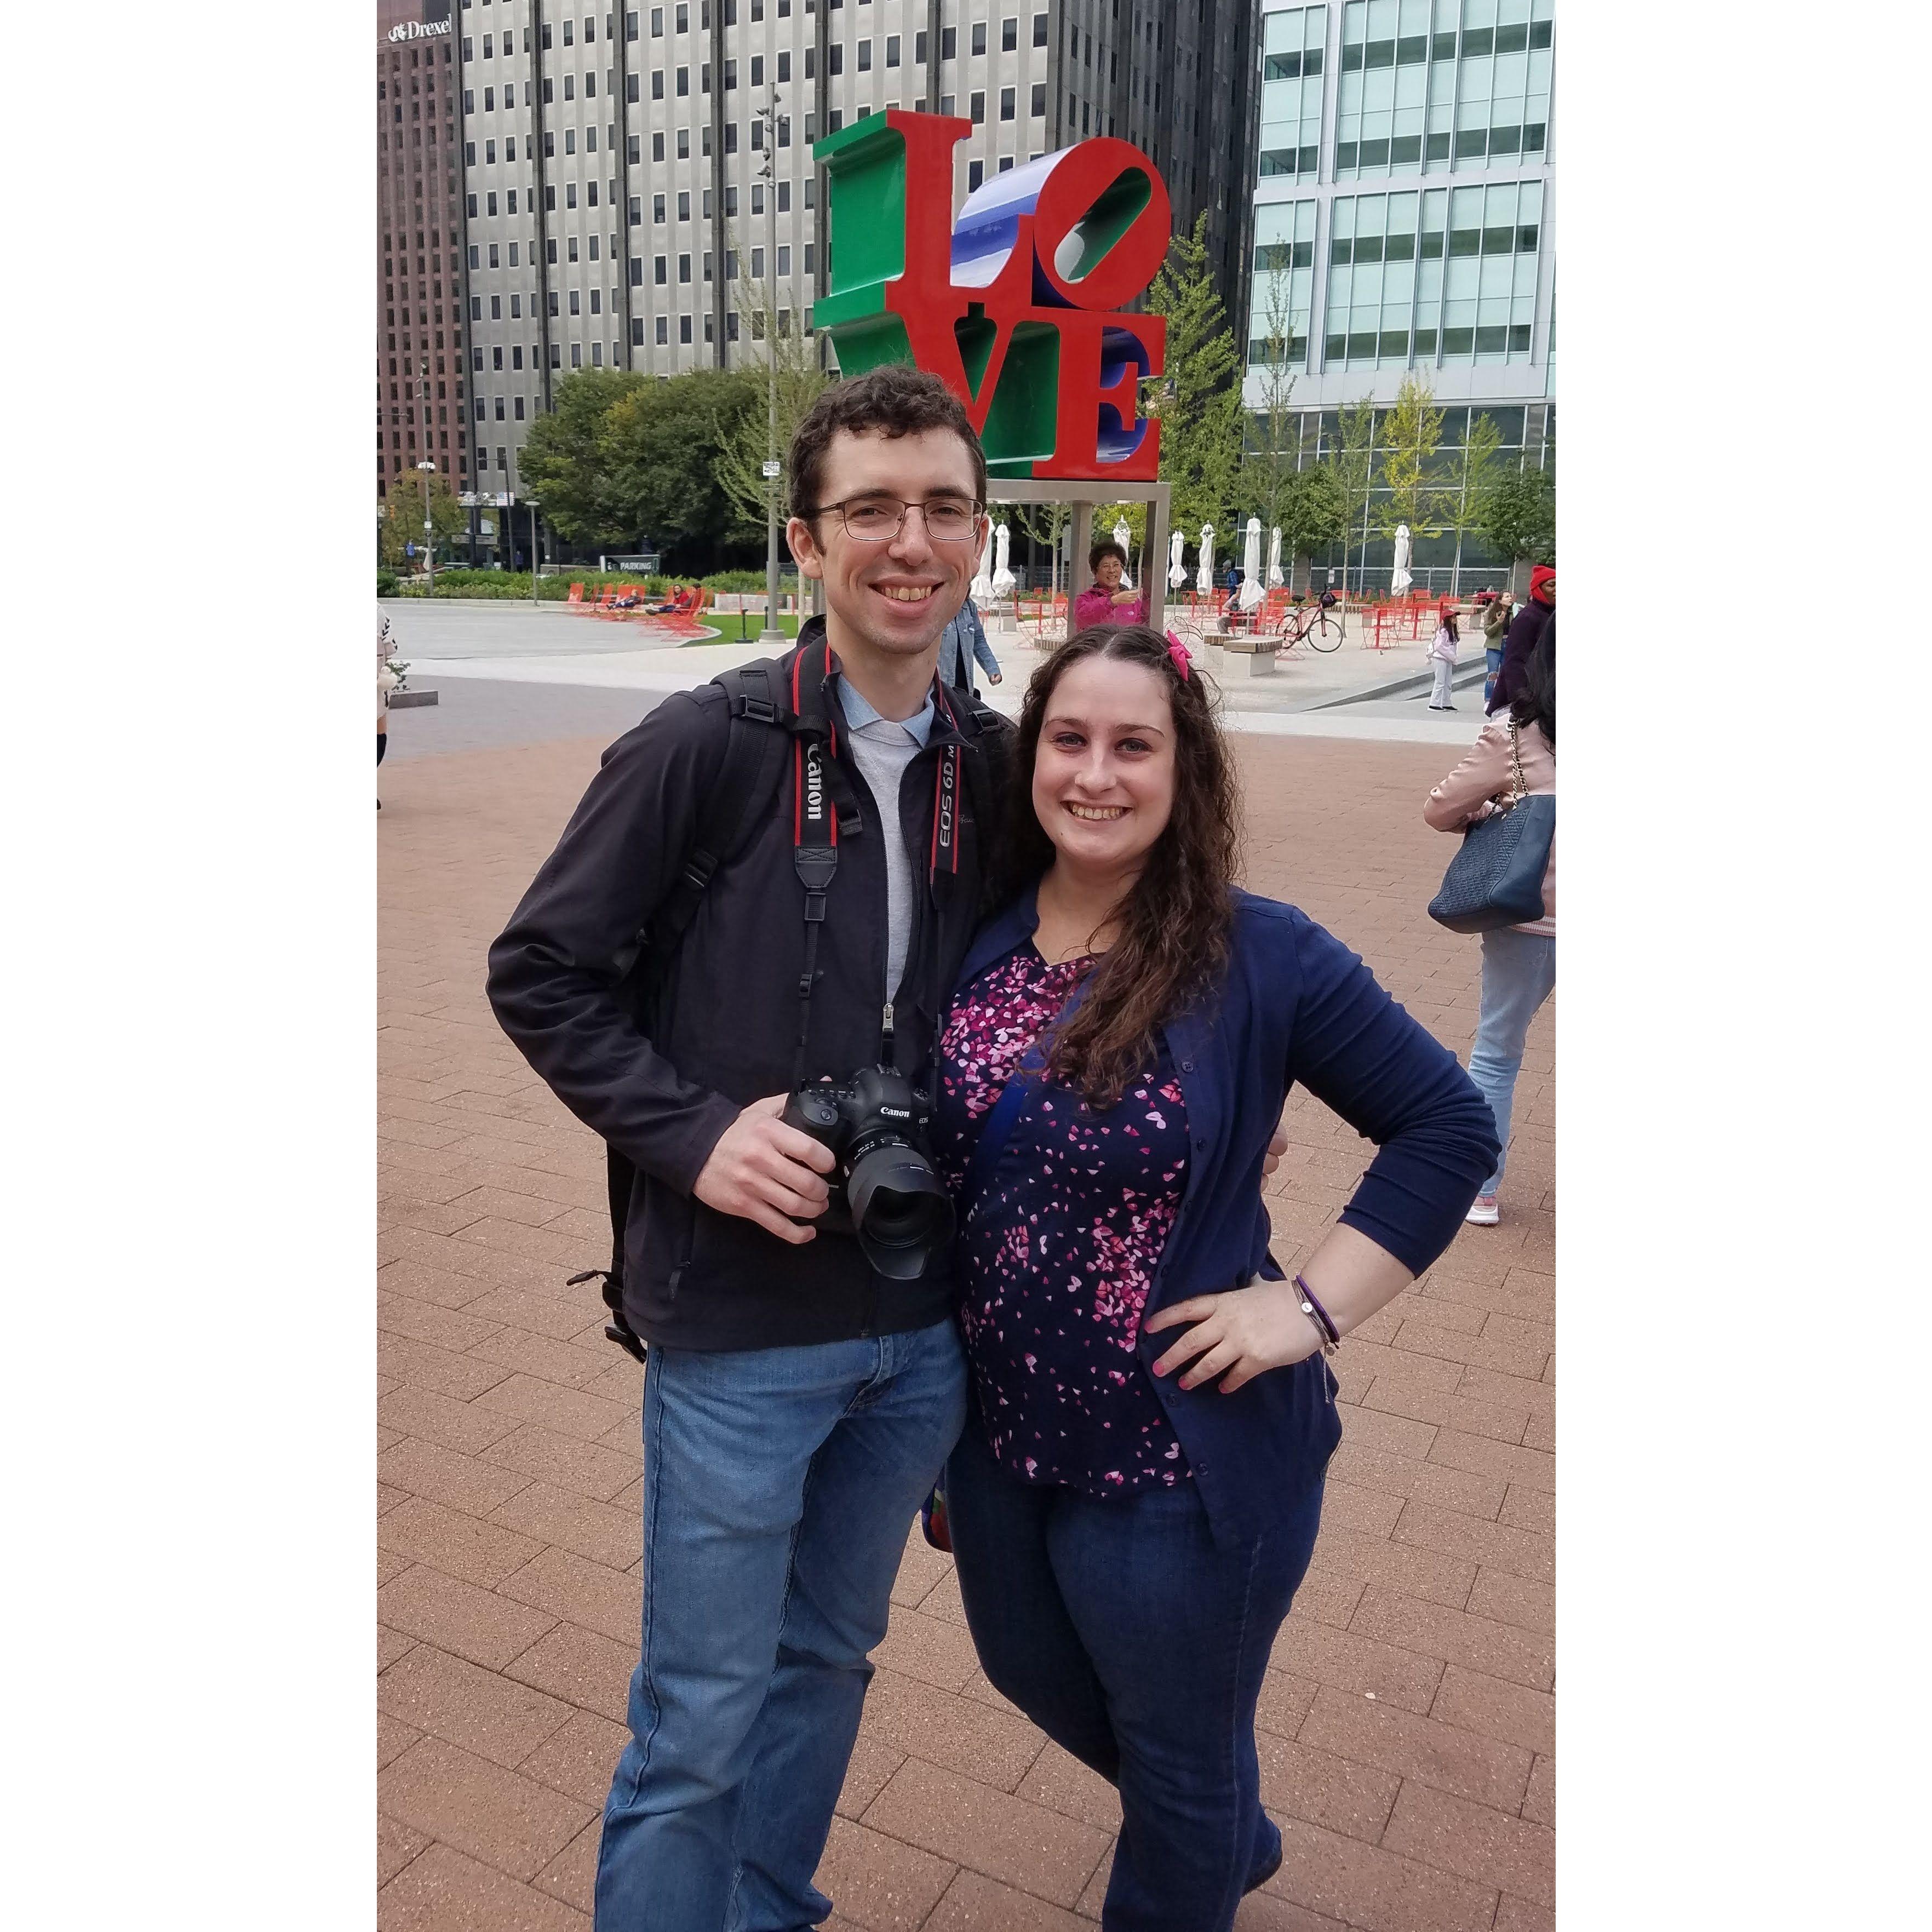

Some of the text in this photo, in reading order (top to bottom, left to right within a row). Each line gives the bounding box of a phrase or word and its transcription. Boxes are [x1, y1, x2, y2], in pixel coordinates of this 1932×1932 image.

[407, 13, 451, 39] Drexel
[620, 562, 652, 570] PARKING
[807, 743, 823, 819] Canon
[943, 762, 953, 789] 6D
[939, 793, 953, 847] EOS
[880, 1107, 910, 1117] Canon
